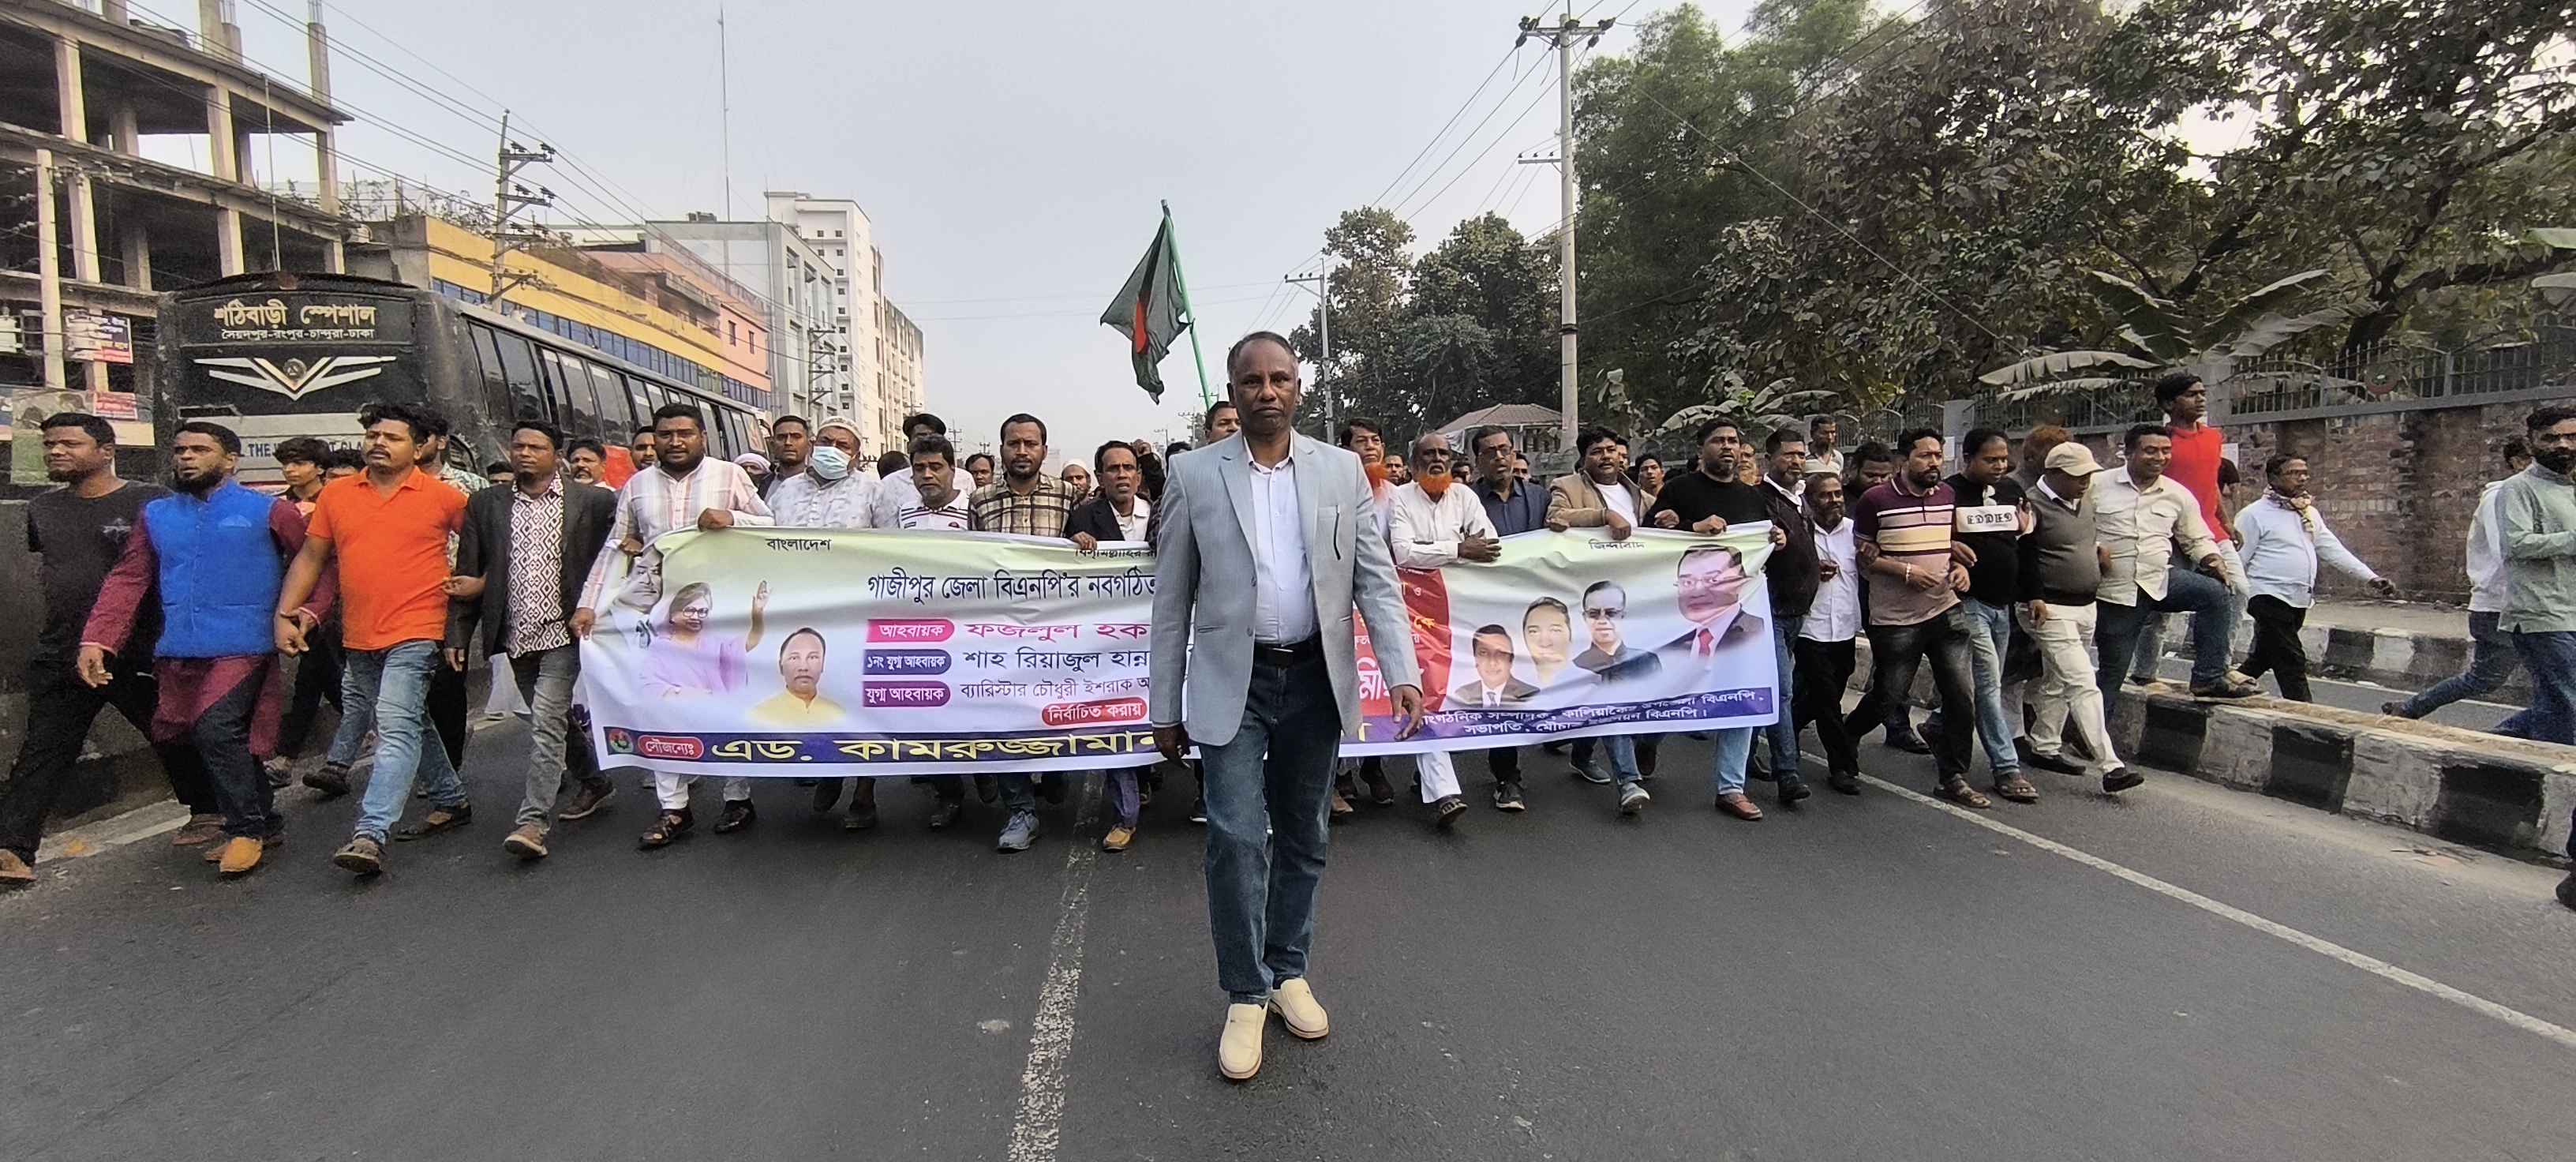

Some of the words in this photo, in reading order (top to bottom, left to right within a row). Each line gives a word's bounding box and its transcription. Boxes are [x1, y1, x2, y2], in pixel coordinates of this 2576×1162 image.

[301, 304, 376, 326] স্পেশাল
[249, 443, 271, 457] THE
[765, 538, 833, 551] বাংলাদেশ
[867, 567, 935, 605] গাজীপুর
[942, 575, 988, 599] জেলা
[994, 568, 1082, 600] বিএনপি'র
[878, 623, 945, 639] আহবায়ক
[964, 624, 1082, 643] ফজলুল
[1093, 623, 1151, 639] হক
[905, 654, 946, 669] আহবায়ক
[963, 650, 1008, 669] শাহ
[1017, 646, 1101, 673] রিয়াজুল
[1108, 650, 1151, 668] হান্ন
[889, 686, 945, 702] আহবায়ক
[960, 679, 1028, 699] ব্যারিস্টার
[1032, 678, 1078, 700] চৌধুরী
[1083, 680, 1133, 695] ইশরাক
[1047, 703, 1103, 723] নির্বাচিত
[1106, 702, 1143, 718] করায়
[711, 740, 813, 761] এড.
